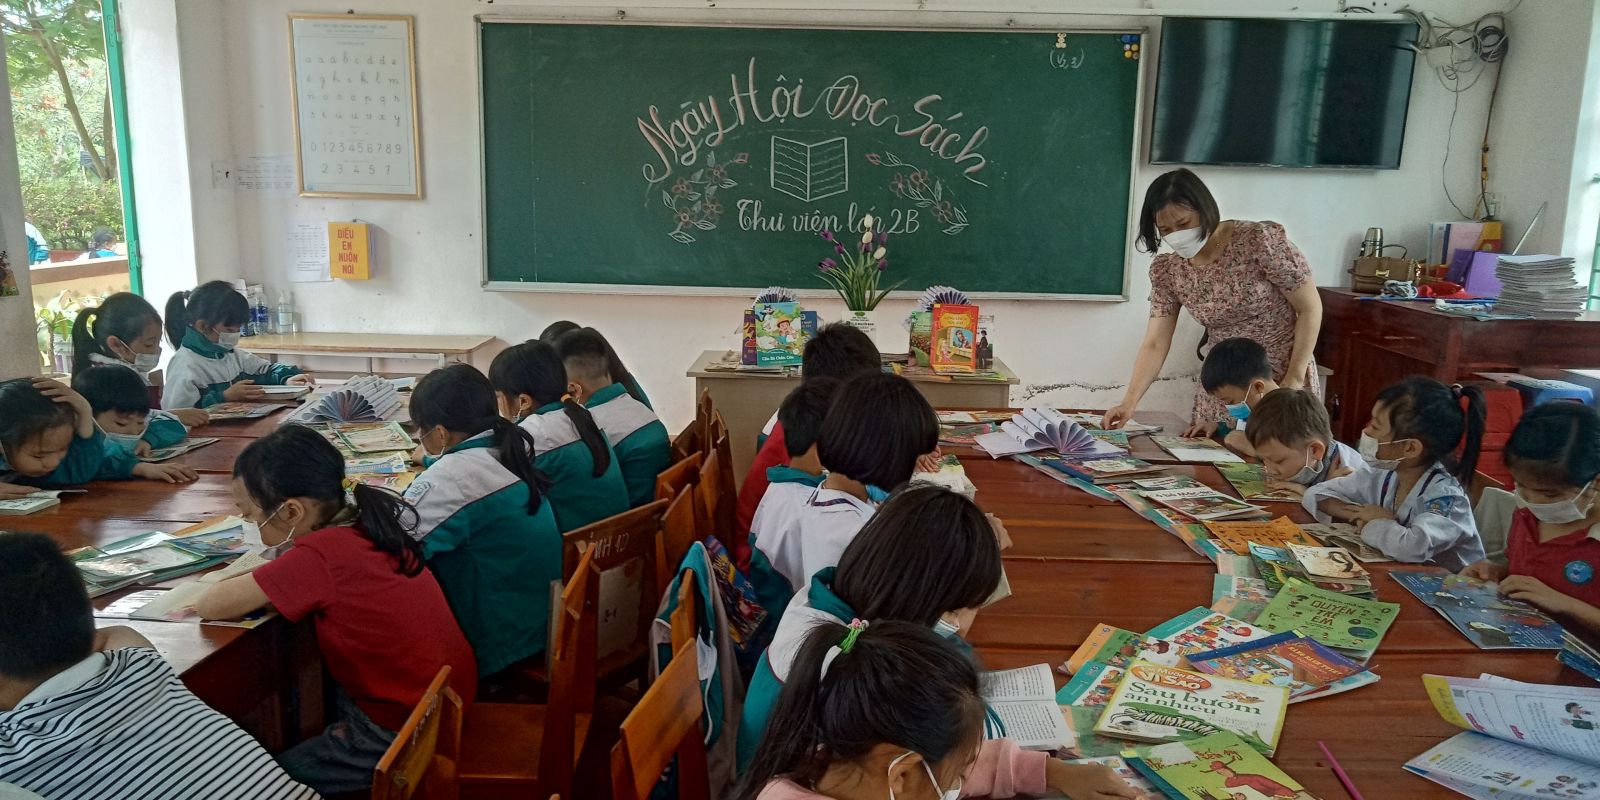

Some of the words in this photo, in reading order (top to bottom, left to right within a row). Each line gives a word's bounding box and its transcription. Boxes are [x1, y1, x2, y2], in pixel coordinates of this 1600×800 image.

[729, 56, 806, 126] Hội
[826, 74, 890, 127] Đọc
[896, 94, 989, 187] Sách
[736, 198, 785, 231] Thư
[791, 209, 843, 235] viện
[887, 208, 920, 233] 2B
[342, 240, 353, 250] EM
[1163, 672, 1201, 690] SAO
